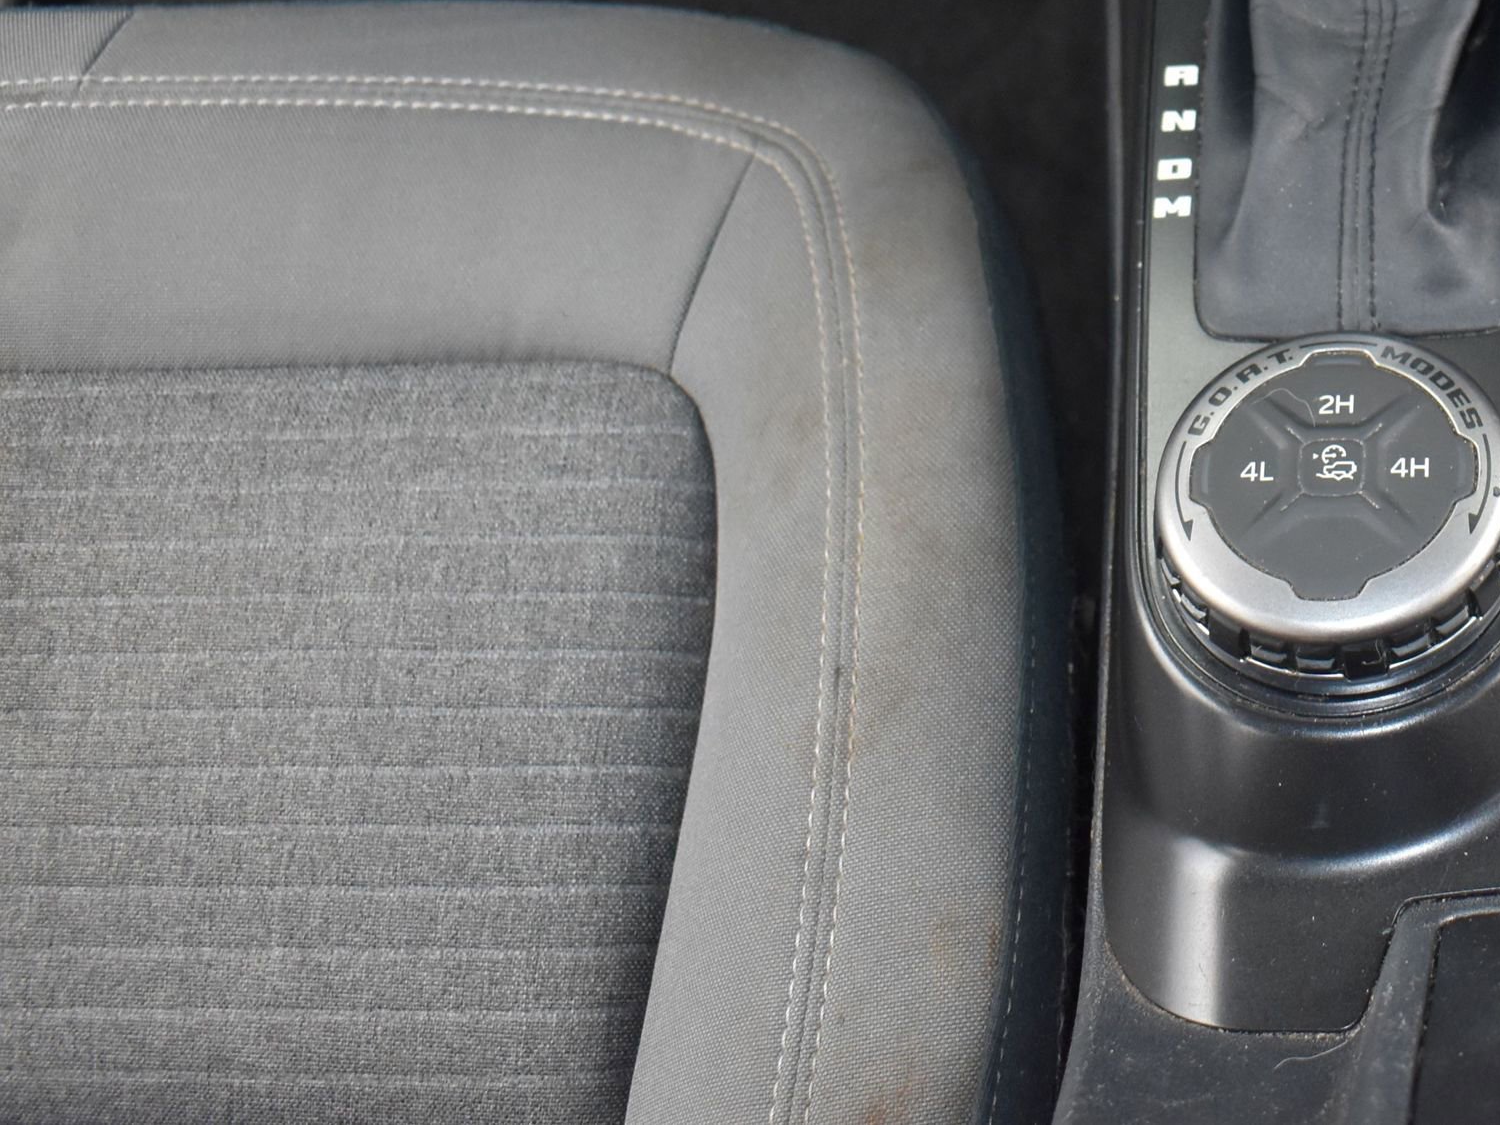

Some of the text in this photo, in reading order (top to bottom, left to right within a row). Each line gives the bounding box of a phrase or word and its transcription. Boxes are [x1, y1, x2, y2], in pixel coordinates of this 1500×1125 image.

[1161, 110, 1197, 132] N
[1153, 195, 1192, 218] M
[1381, 345, 1484, 430] MODES
[1318, 394, 1355, 416] 2H
[1239, 461, 1274, 483] 4L
[1390, 457, 1430, 479] 4H
